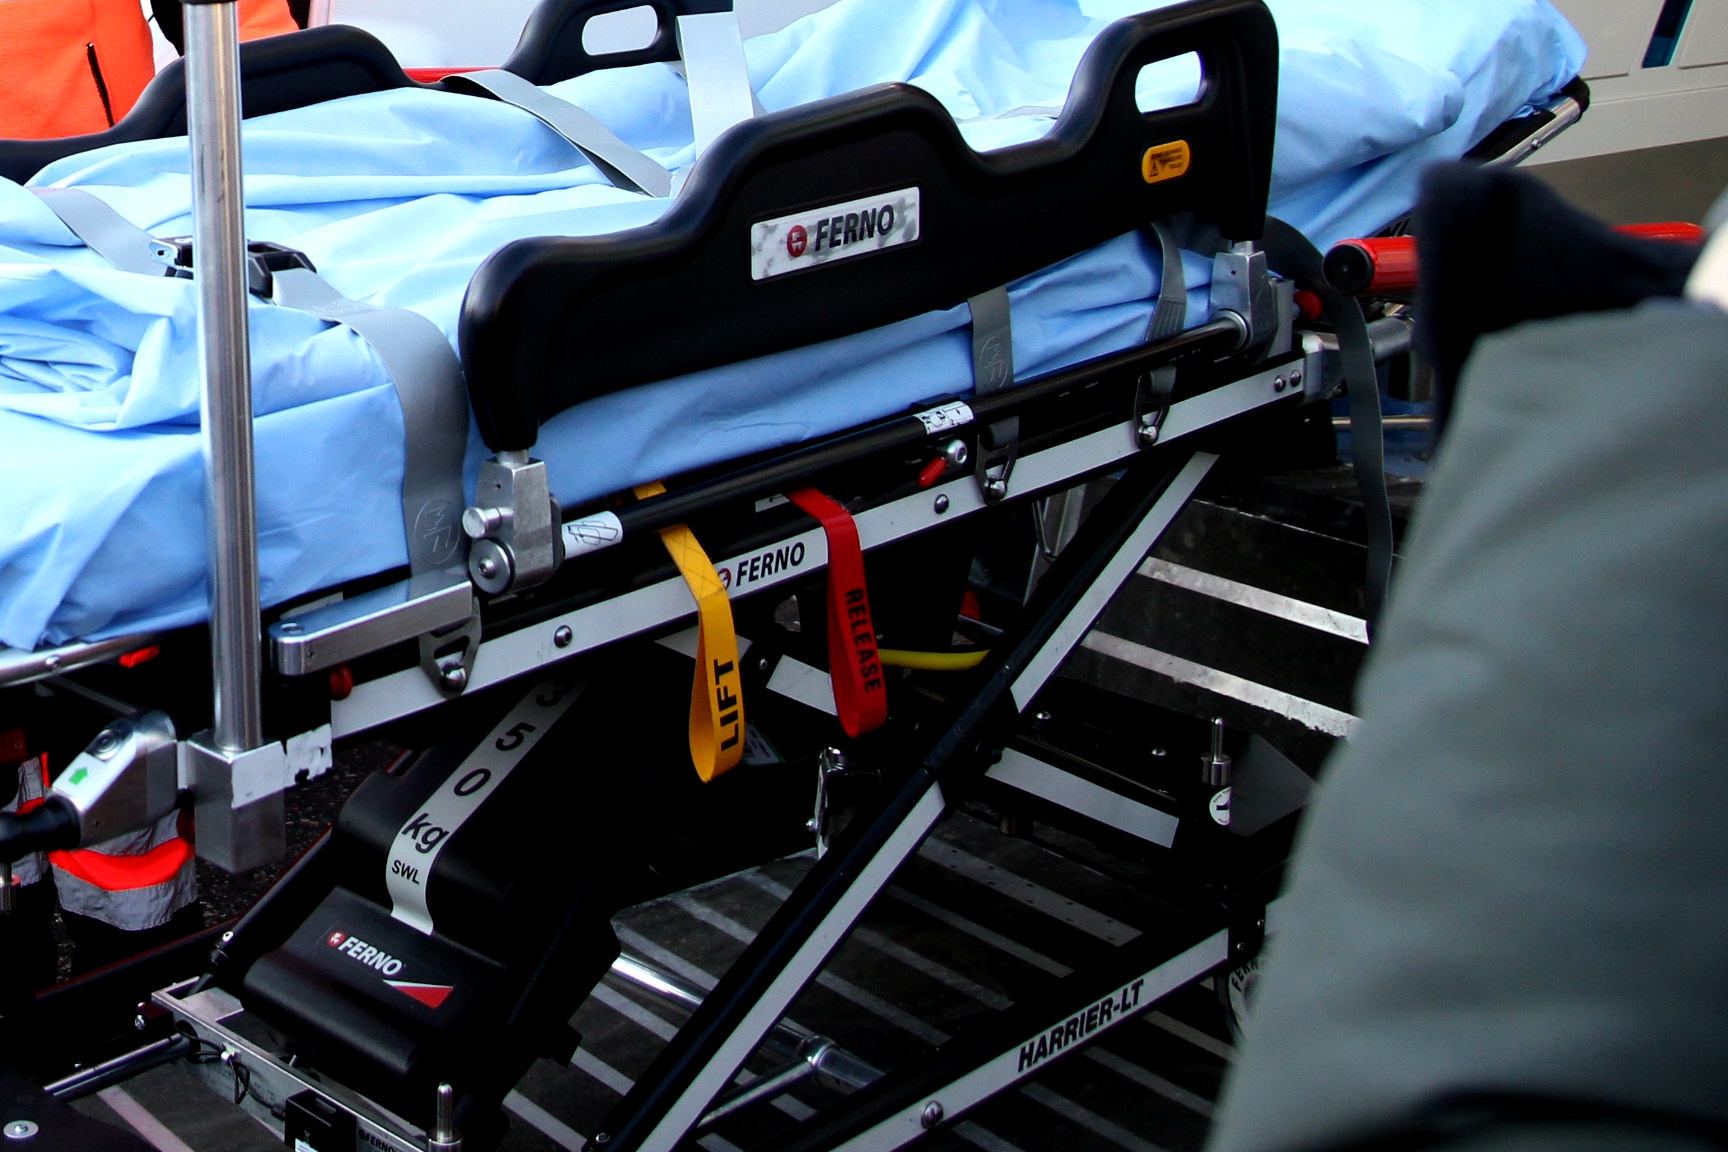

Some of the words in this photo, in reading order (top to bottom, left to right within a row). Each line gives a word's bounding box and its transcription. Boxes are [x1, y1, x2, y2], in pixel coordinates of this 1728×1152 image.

[814, 204, 895, 252] FERNO
[735, 541, 805, 587] FERNO
[845, 587, 882, 694] RELEASE
[713, 658, 739, 751] LIFT
[402, 813, 449, 854] kg
[391, 860, 421, 885] SWL
[337, 936, 403, 976] FERNO
[1018, 979, 1144, 1072] HARRIER-LT
